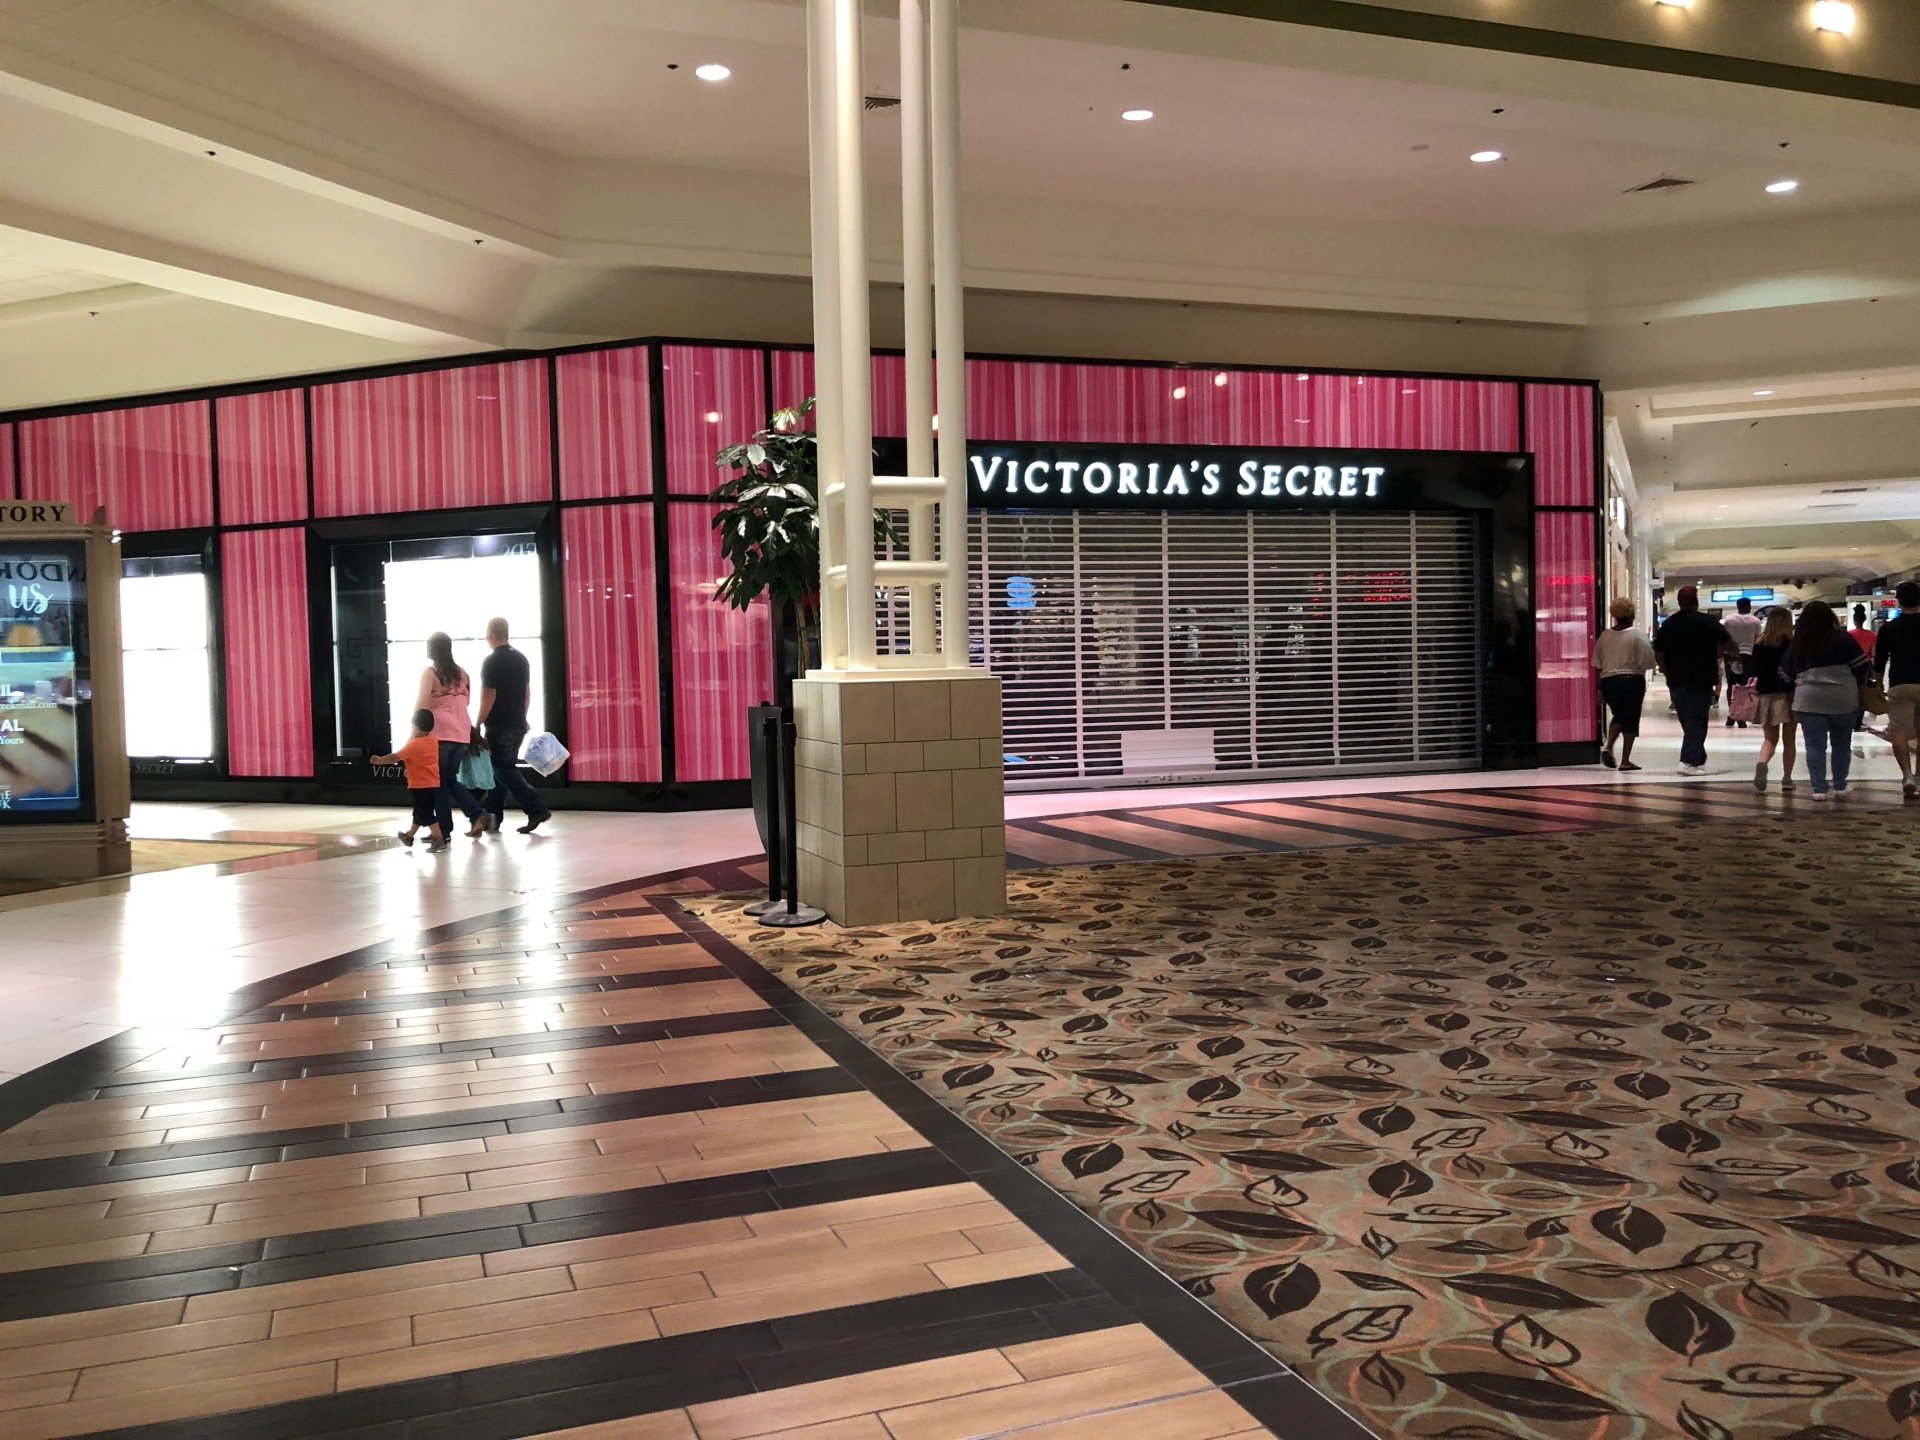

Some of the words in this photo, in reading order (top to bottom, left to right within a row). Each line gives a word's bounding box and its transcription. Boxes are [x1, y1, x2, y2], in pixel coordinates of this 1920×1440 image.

[969, 455, 1220, 496] VICTORIA'S
[1236, 460, 1385, 497] SECRET
[8, 583, 54, 614] us
[135, 762, 176, 774] SECRET
